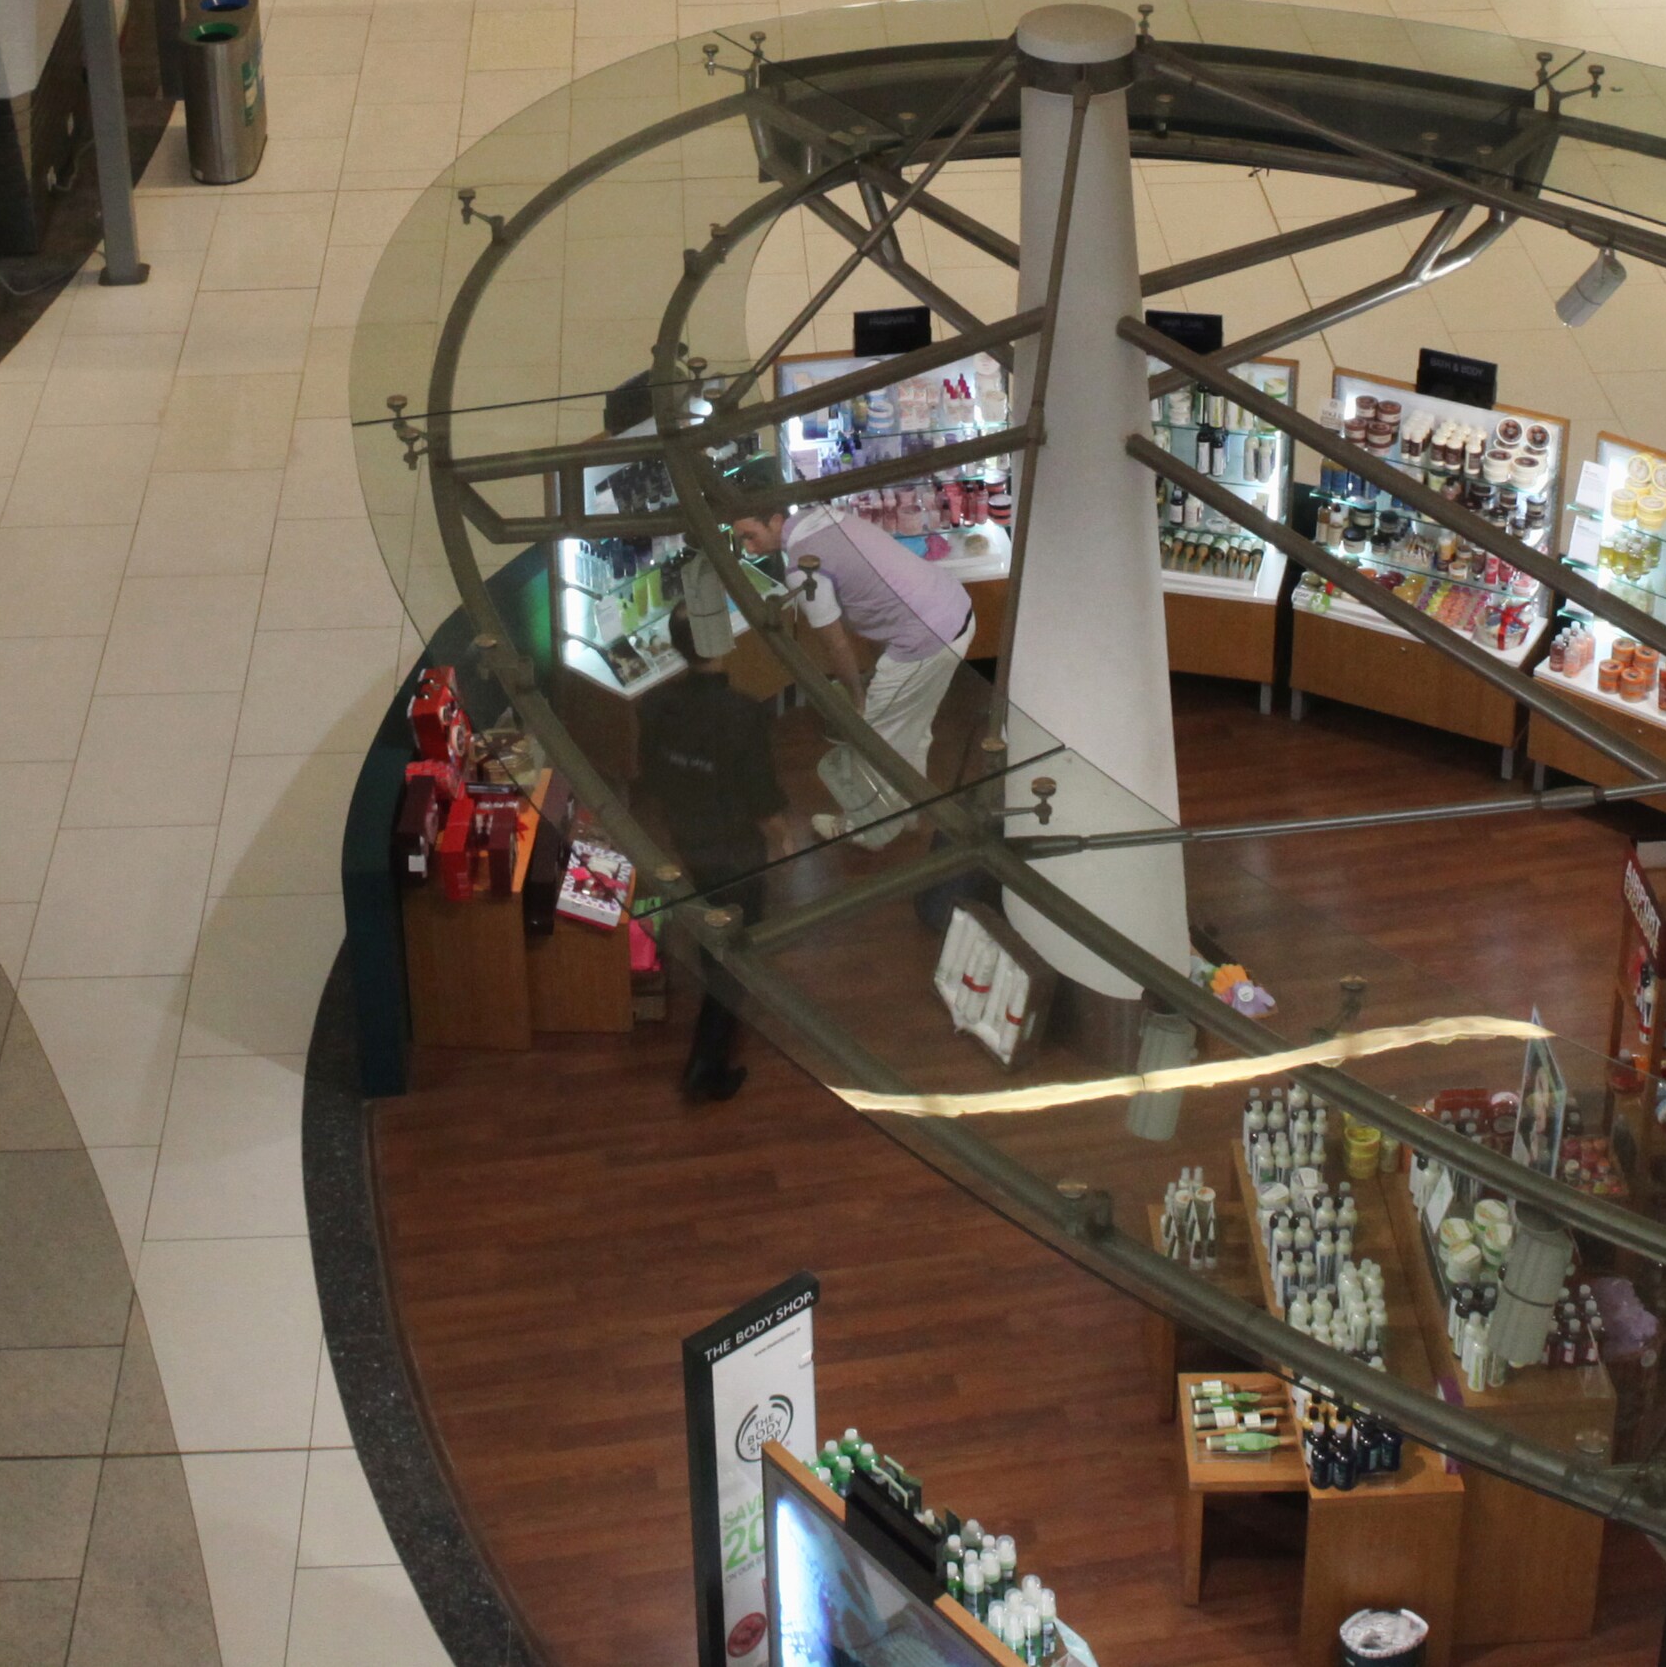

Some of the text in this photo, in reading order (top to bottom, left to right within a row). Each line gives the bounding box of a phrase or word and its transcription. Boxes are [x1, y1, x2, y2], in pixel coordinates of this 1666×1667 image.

[704, 1338, 732, 1363] THE
[735, 1313, 775, 1345] BODY
[747, 1416, 783, 1447] BODY
[754, 1412, 775, 1431] THE
